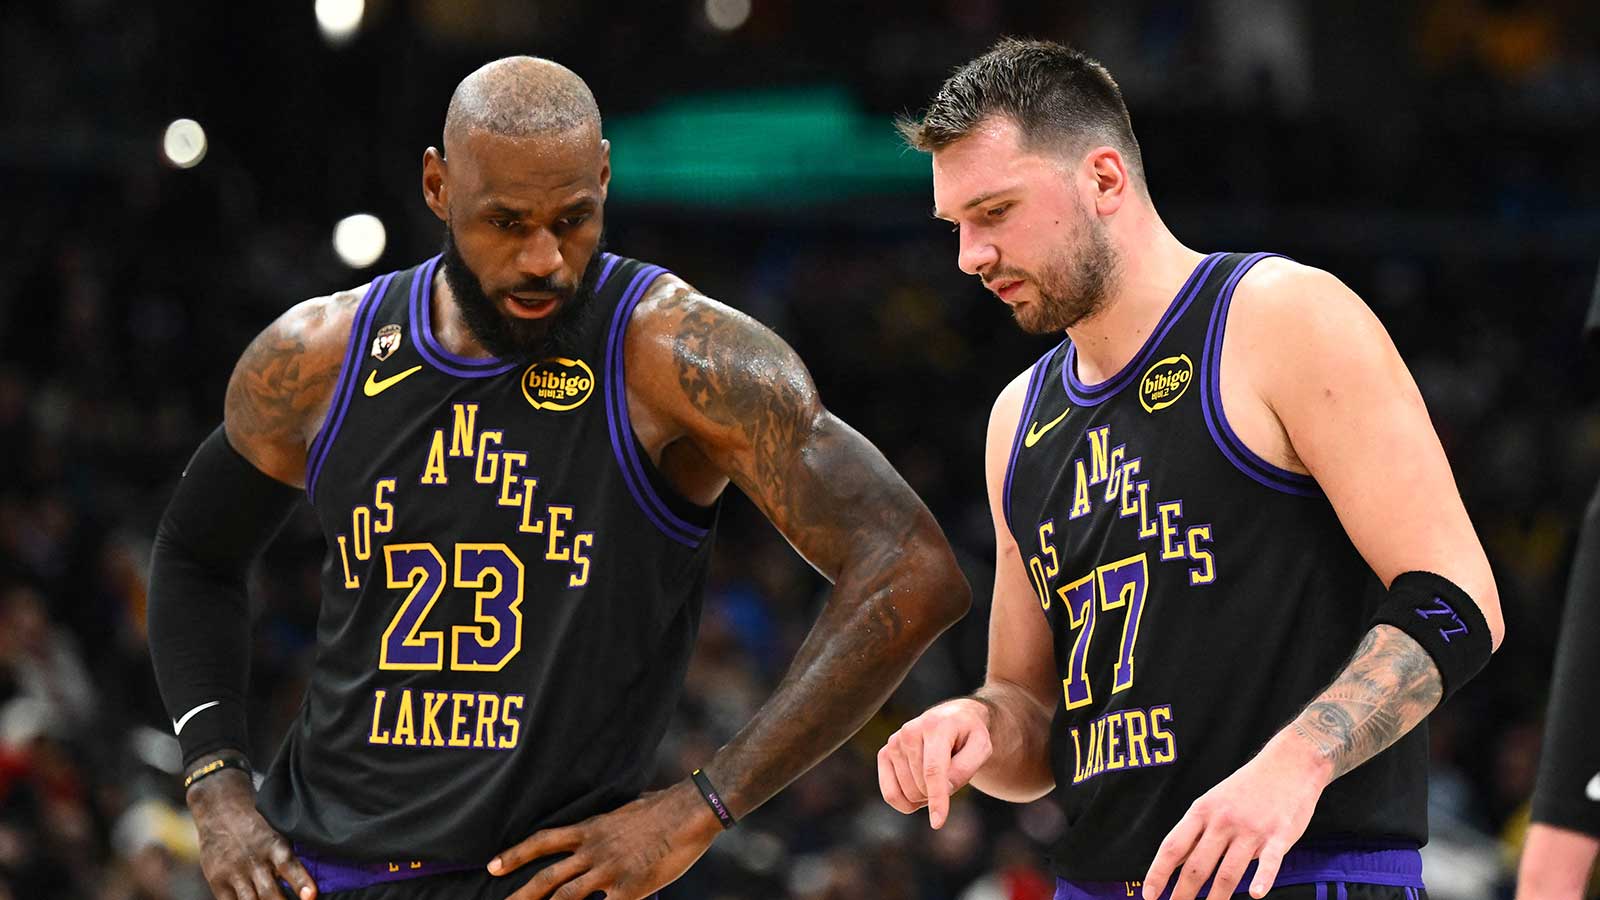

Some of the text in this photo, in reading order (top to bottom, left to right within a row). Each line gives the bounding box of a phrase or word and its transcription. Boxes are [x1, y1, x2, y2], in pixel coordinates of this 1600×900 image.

[529, 370, 590, 397] bibigo
[538, 388, 565, 400] 비비고
[1144, 369, 1190, 395] bibigo
[337, 402, 595, 589] LOS ANGELES
[1028, 424, 1217, 611] OS ANGELES
[378, 542, 525, 672] 23
[1056, 552, 1149, 711] 77
[1414, 597, 1469, 643] 77
[368, 687, 526, 750] LAKERS
[1070, 703, 1178, 785] LAKERS
